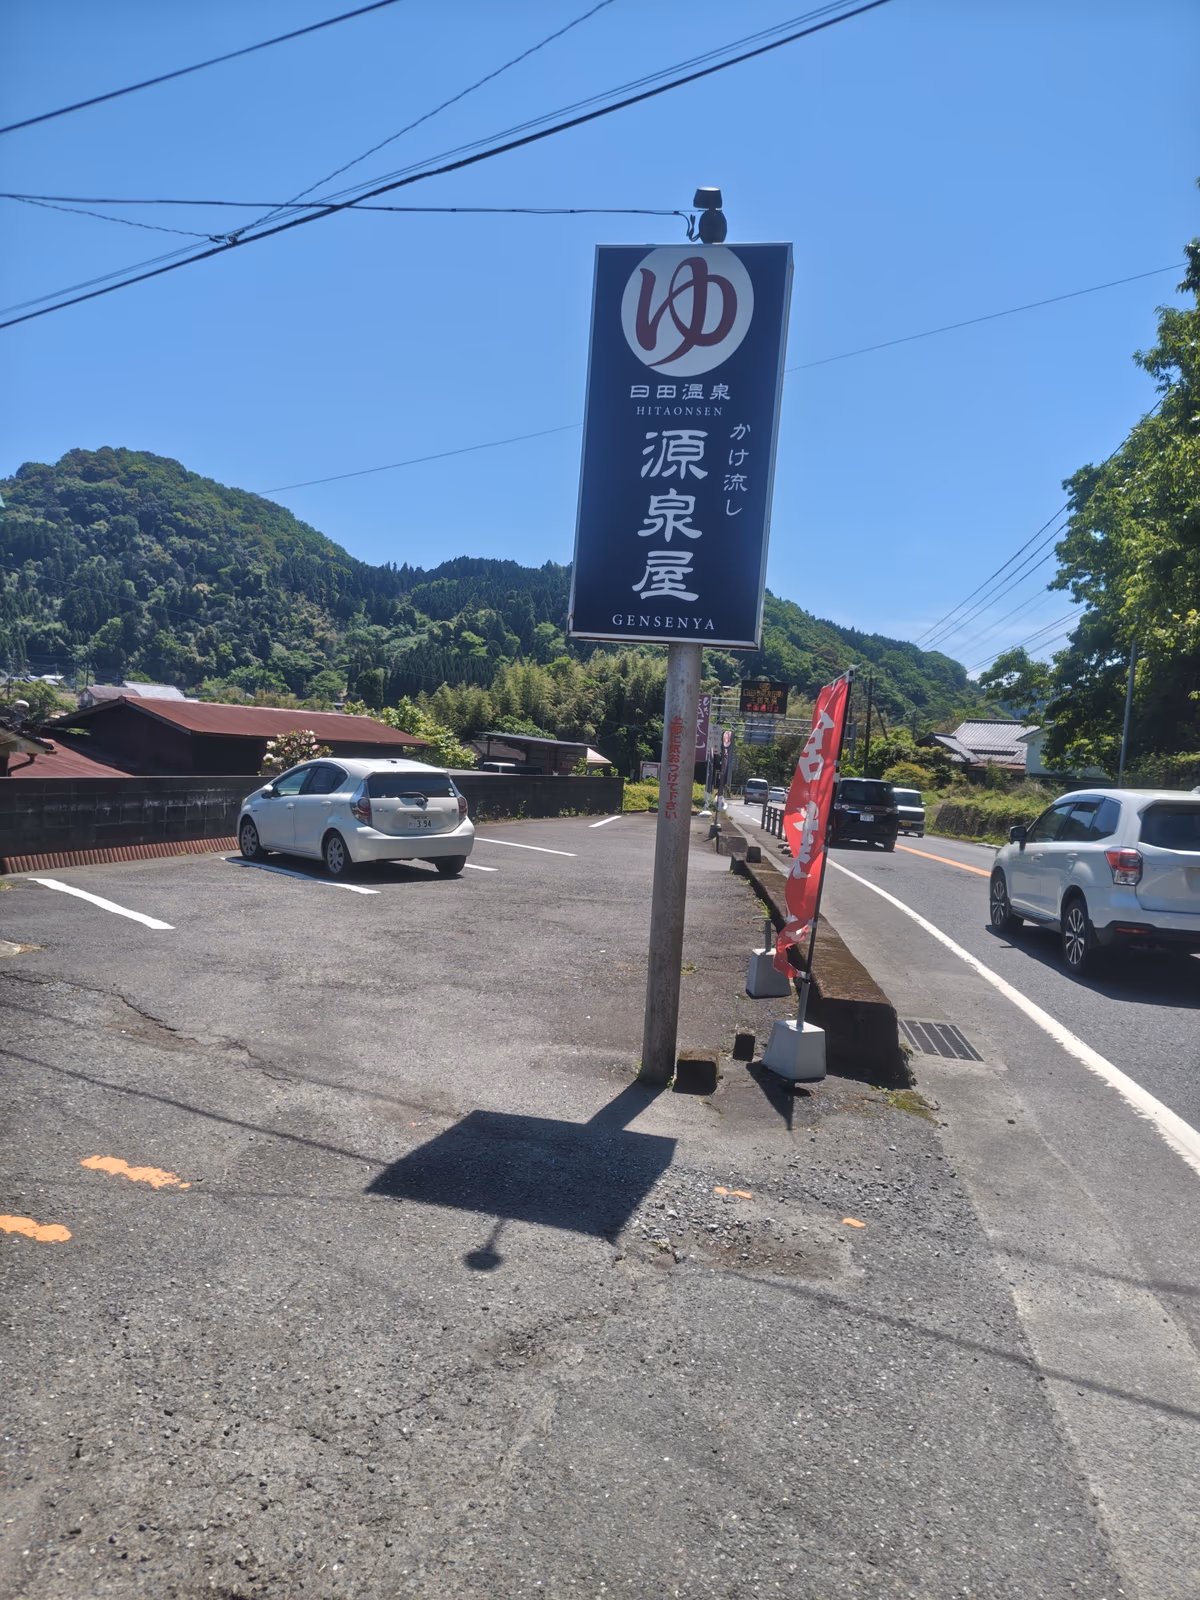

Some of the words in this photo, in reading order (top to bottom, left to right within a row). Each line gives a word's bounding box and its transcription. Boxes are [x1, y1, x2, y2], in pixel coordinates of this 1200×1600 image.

[635, 256, 738, 367] ゆ
[629, 383, 731, 401] 日田温泉
[635, 406, 723, 417] HITAONSEN
[723, 423, 751, 516] かけ流し
[631, 429, 709, 603] 源泉屋
[612, 614, 715, 631] GENSENYA
